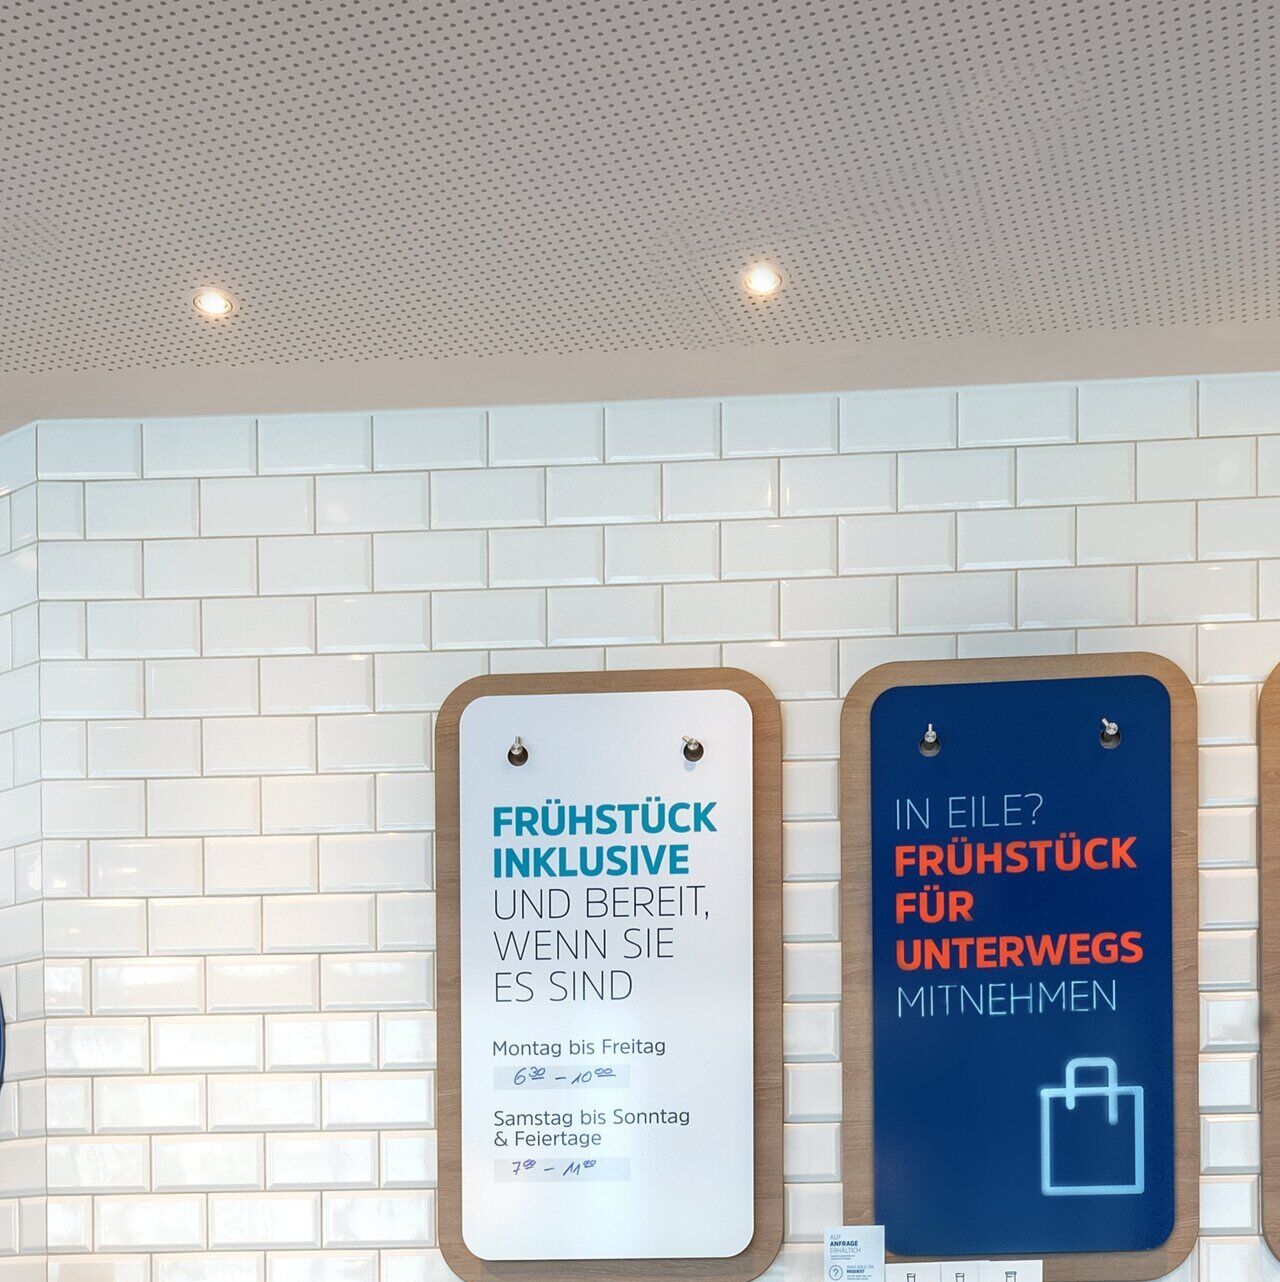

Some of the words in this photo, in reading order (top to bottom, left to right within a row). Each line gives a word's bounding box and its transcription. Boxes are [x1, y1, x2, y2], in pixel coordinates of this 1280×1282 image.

[493, 797, 717, 837] FRÜHSTÜCK
[896, 798, 930, 830] IN
[948, 793, 1043, 829] EILE?
[493, 844, 689, 878] INKLUSIVE
[895, 832, 1137, 877] FRÜHSTÜCK
[494, 888, 570, 920] UND
[586, 885, 709, 919] BEREIT,
[895, 885, 974, 924] FÜR
[493, 929, 606, 961] WENN
[623, 928, 674, 958] SIE
[896, 931, 1144, 971] UNTERWEGS
[495, 971, 533, 1002] ES
[549, 970, 632, 1001] SIND
[898, 979, 1116, 1018] MITNEHMEN
[493, 1040, 562, 1057] Montag
[569, 1039, 595, 1055] bis
[602, 1039, 666, 1056] Freitag
[494, 1110, 573, 1128] Samstag
[580, 1109, 606, 1125] bis
[613, 1109, 690, 1125] Sonntag
[494, 1131, 508, 1146] &
[515, 1131, 602, 1148] Feiertage
